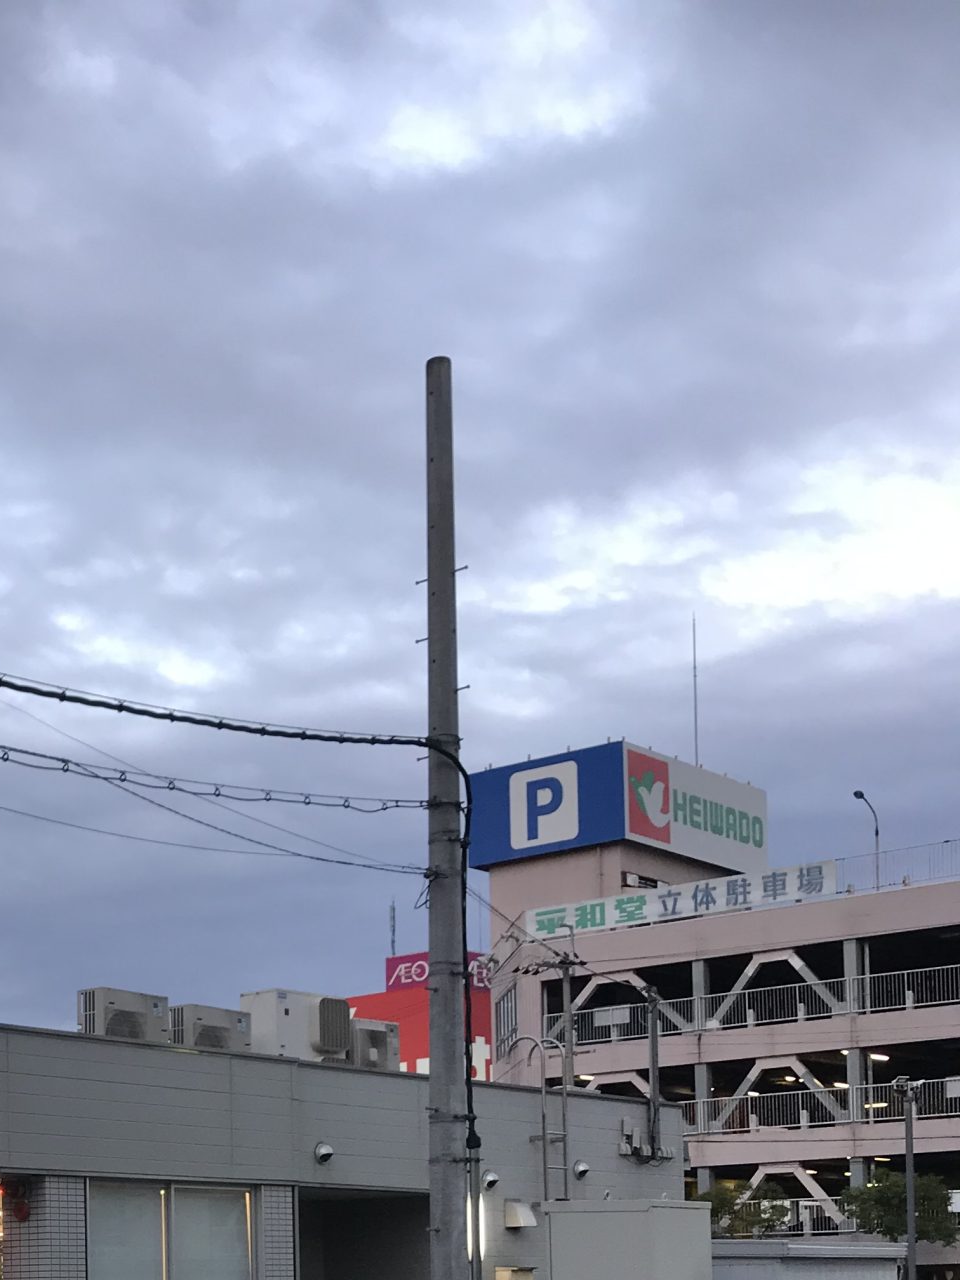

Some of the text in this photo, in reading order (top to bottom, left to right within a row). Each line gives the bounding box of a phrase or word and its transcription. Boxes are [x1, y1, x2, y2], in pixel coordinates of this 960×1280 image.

[527, 776, 563, 841] P
[672, 788, 764, 849] HEIWADO
[388, 961, 429, 986] AEO
